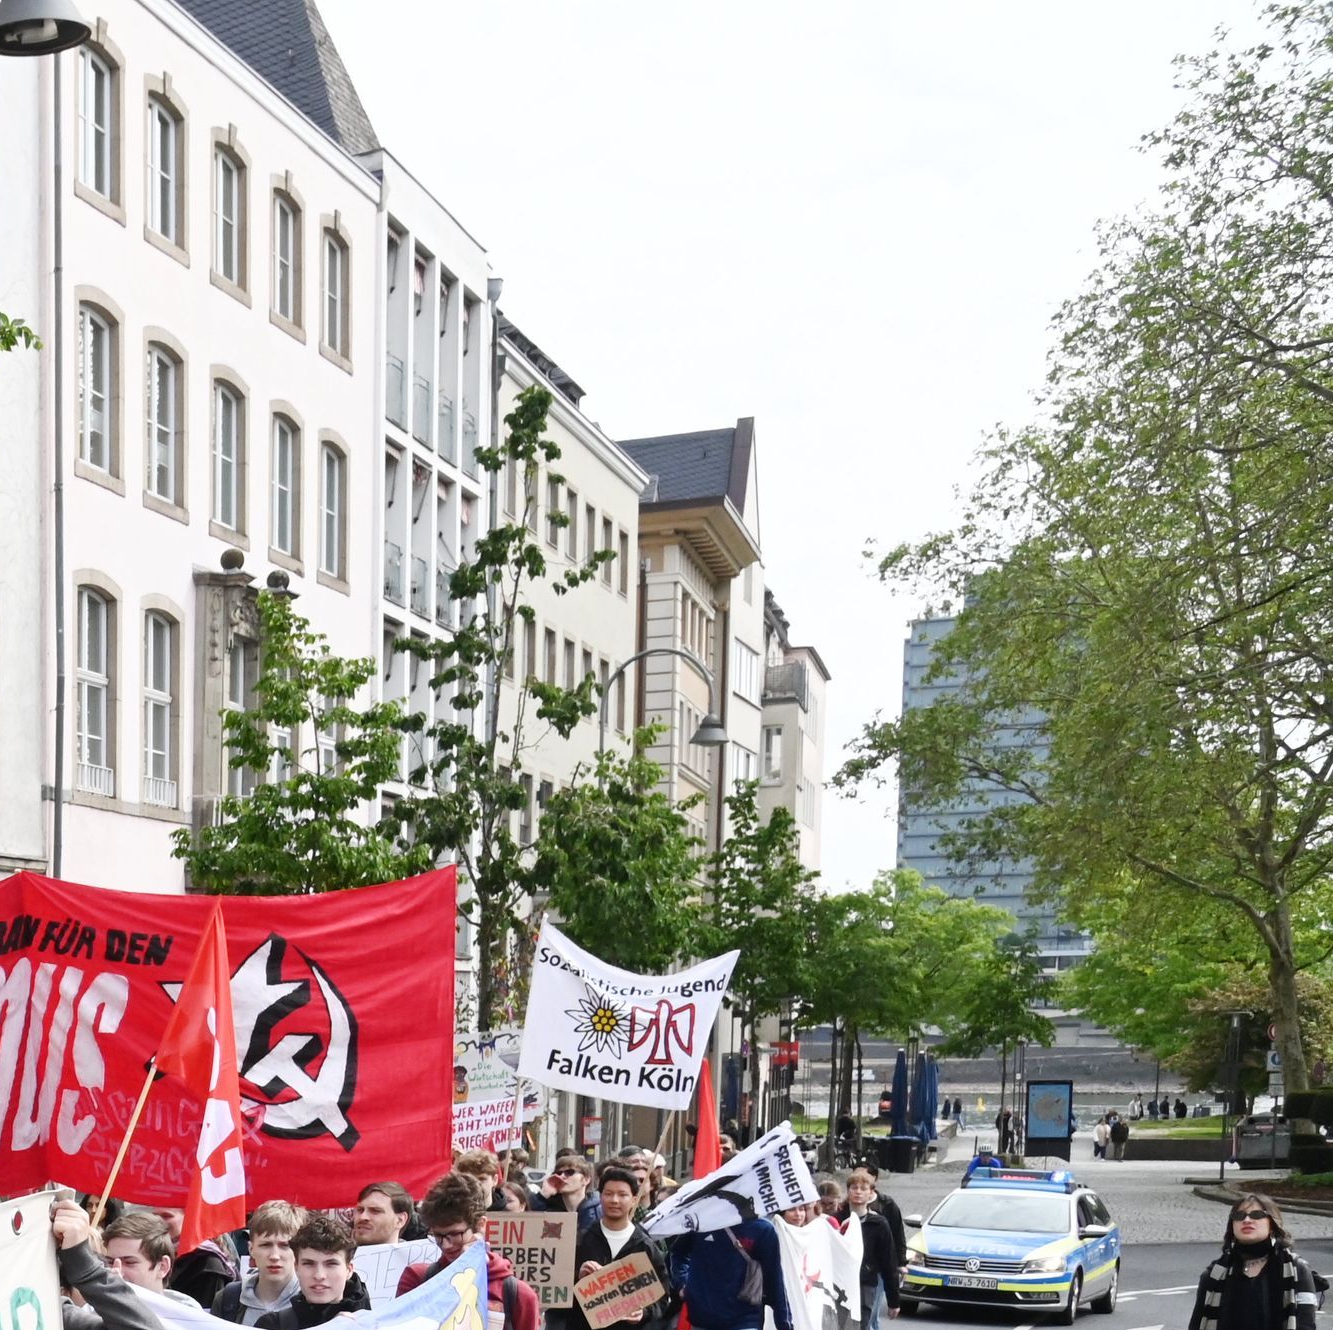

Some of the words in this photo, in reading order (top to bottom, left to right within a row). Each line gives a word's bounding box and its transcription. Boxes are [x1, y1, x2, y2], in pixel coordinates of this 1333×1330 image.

[38, 918, 96, 960] FÜR
[104, 929, 173, 966] DEN
[659, 974, 726, 998] Jugend
[547, 1050, 631, 1086] Falken
[638, 1066, 694, 1092] Köln
[486, 1221, 525, 1245] EIN
[578, 1263, 637, 1297] WAFFEN
